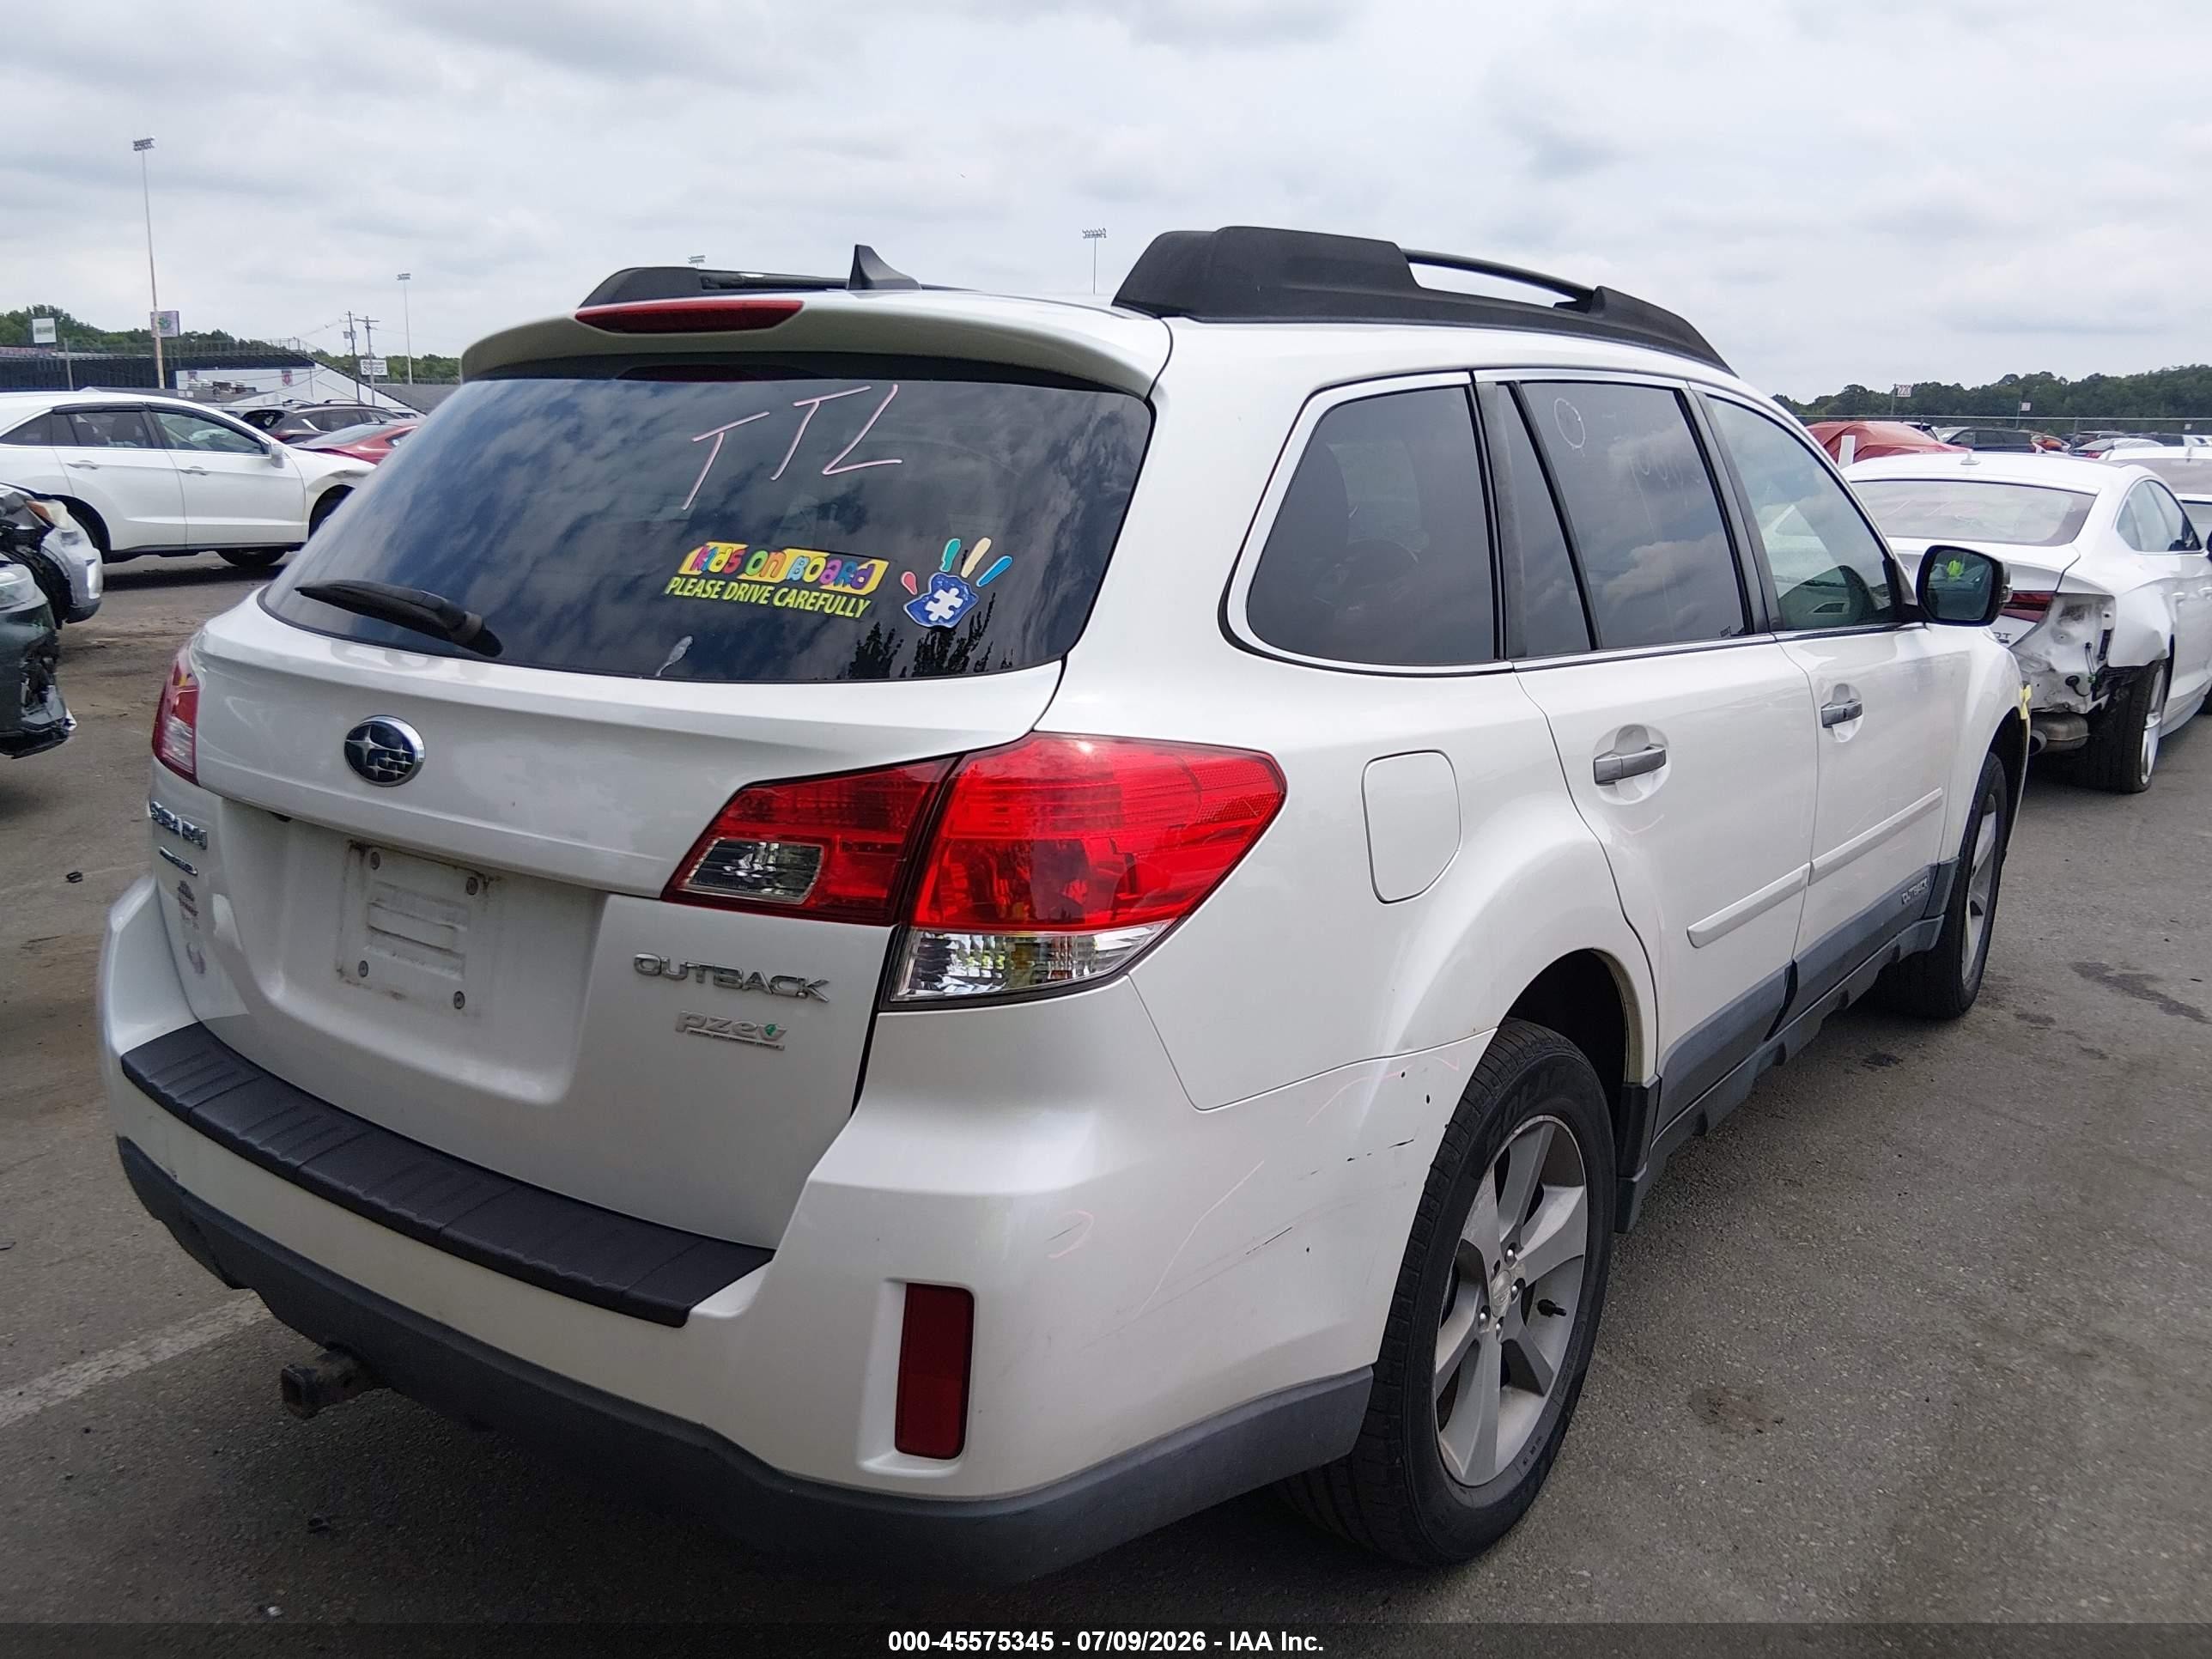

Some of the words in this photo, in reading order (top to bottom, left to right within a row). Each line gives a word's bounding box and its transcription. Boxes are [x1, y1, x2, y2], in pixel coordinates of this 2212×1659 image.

[664, 577, 726, 599] PLEASE
[721, 581, 775, 605] DRIVE
[774, 586, 872, 618] CAREFULLY
[634, 952, 830, 1003] OUTBACK
